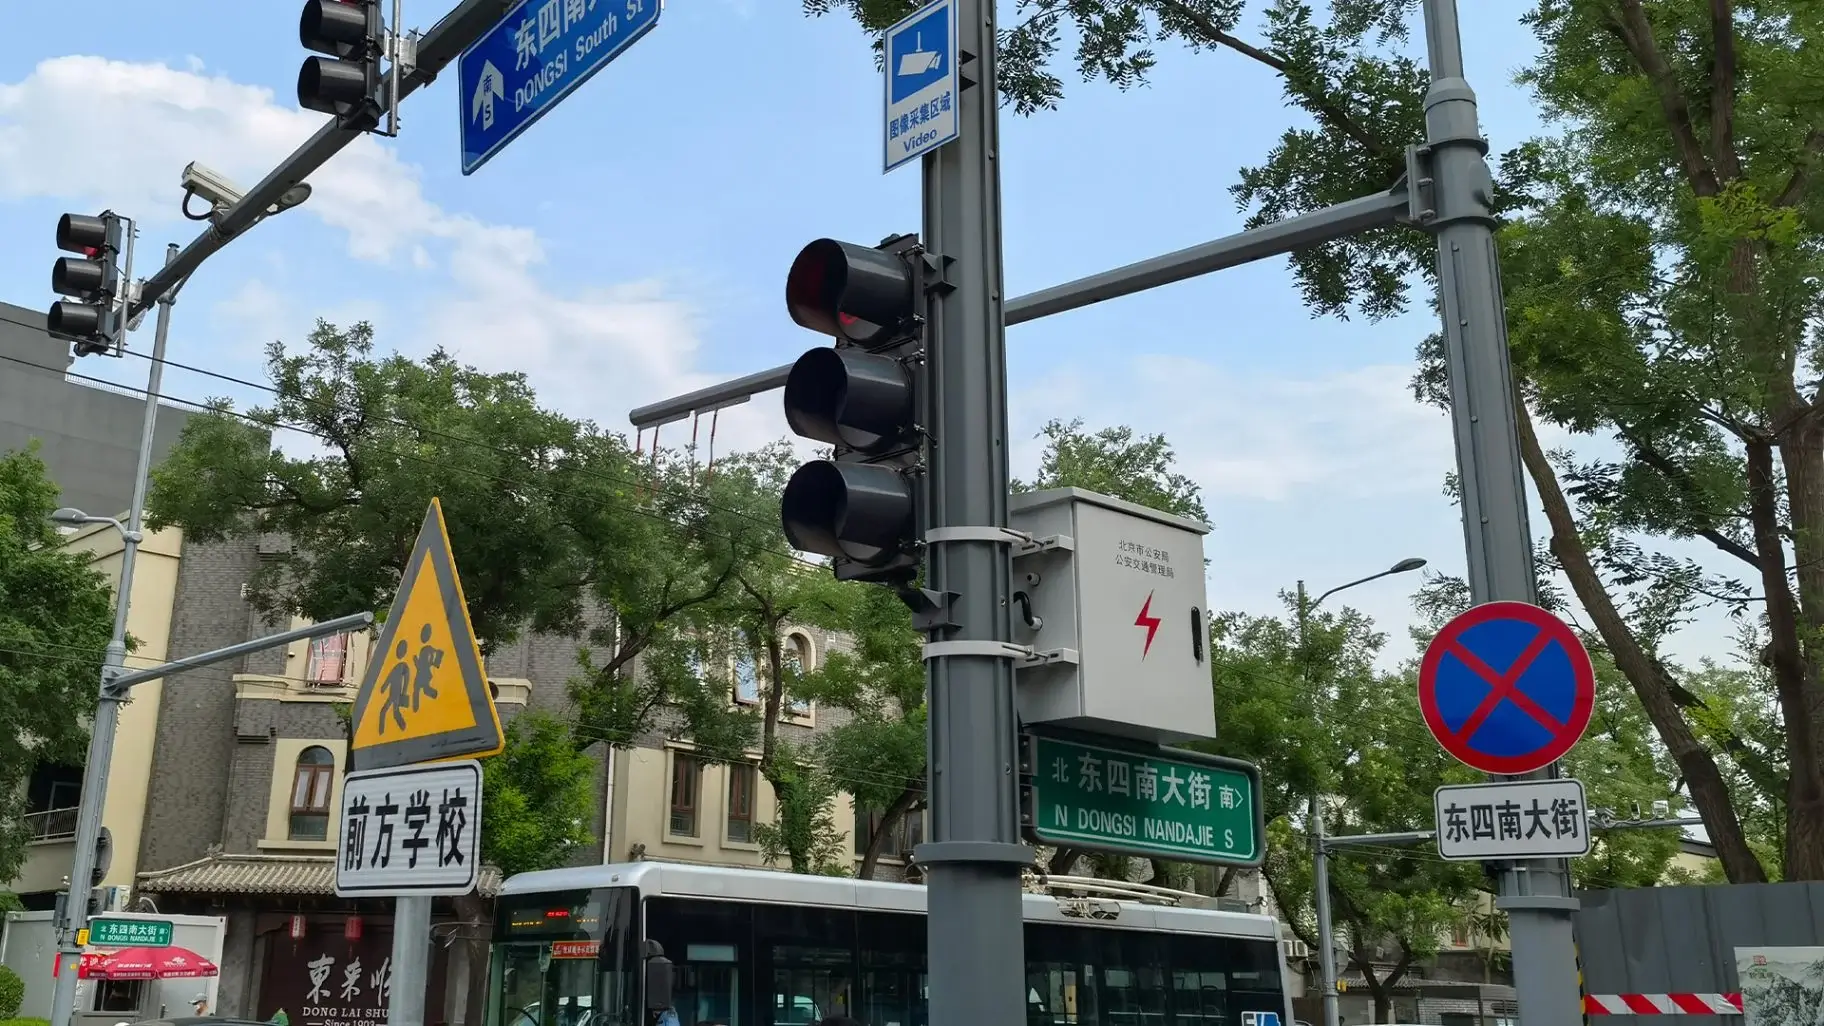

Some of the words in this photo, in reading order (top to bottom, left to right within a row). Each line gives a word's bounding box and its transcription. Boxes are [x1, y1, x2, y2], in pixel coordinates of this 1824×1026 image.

[515, 0, 597, 71] 东四南
[515, 50, 568, 112] DONGSI
[576, 12, 617, 61] South
[483, 75, 492, 95] 南
[484, 104, 491, 121] S
[889, 91, 951, 140] 图像采集区域
[903, 128, 937, 152] Video
[1116, 554, 1174, 578] 公安交通管理局
[1119, 540, 1169, 562] 北京市公安局
[1052, 757, 1069, 783] 北
[1077, 752, 1211, 810] 东四南大街
[1219, 785, 1234, 810] 南
[345, 787, 468, 871] 前方学校
[1055, 805, 1068, 827] N
[1078, 808, 1136, 837] DONGSI
[1144, 817, 1214, 847] NANDAJIE
[1224, 829, 1234, 849] S
[1444, 798, 1579, 843] 东四南大街
[109, 923, 157, 936] 东四南大街
[302, 1007, 337, 1017] DONG
[341, 1008, 361, 1018] LAI
